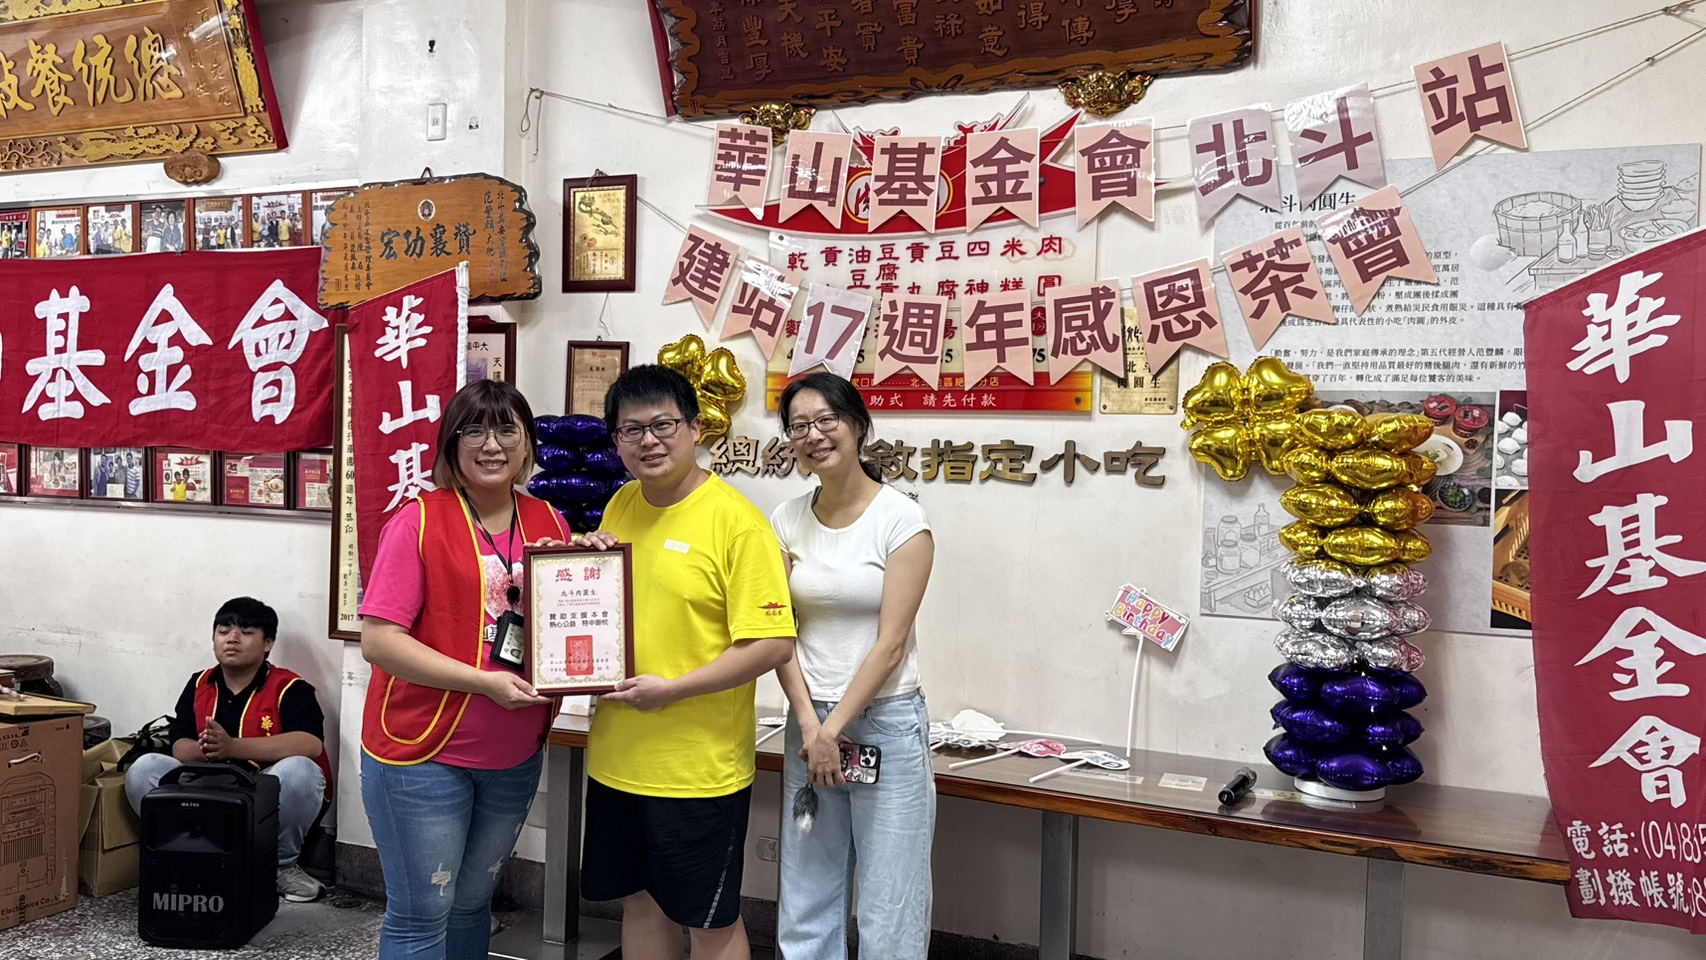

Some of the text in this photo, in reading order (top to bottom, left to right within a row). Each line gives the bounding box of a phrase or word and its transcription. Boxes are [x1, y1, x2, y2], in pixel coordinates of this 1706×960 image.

[815, 9, 848, 72] 平安
[1259, 191, 1356, 214] 斗圓生
[22, 278, 330, 425] 基金會
[868, 393, 997, 408] 助式 請先付款
[709, 437, 1166, 487] 總統敘指定小吃
[1566, 270, 1706, 809] 華山基金會
[555, 567, 602, 582] 感謝
[1112, 602, 1174, 647] Birthday
[1126, 590, 1171, 625] Happy
[153, 891, 225, 913] MIPRO
